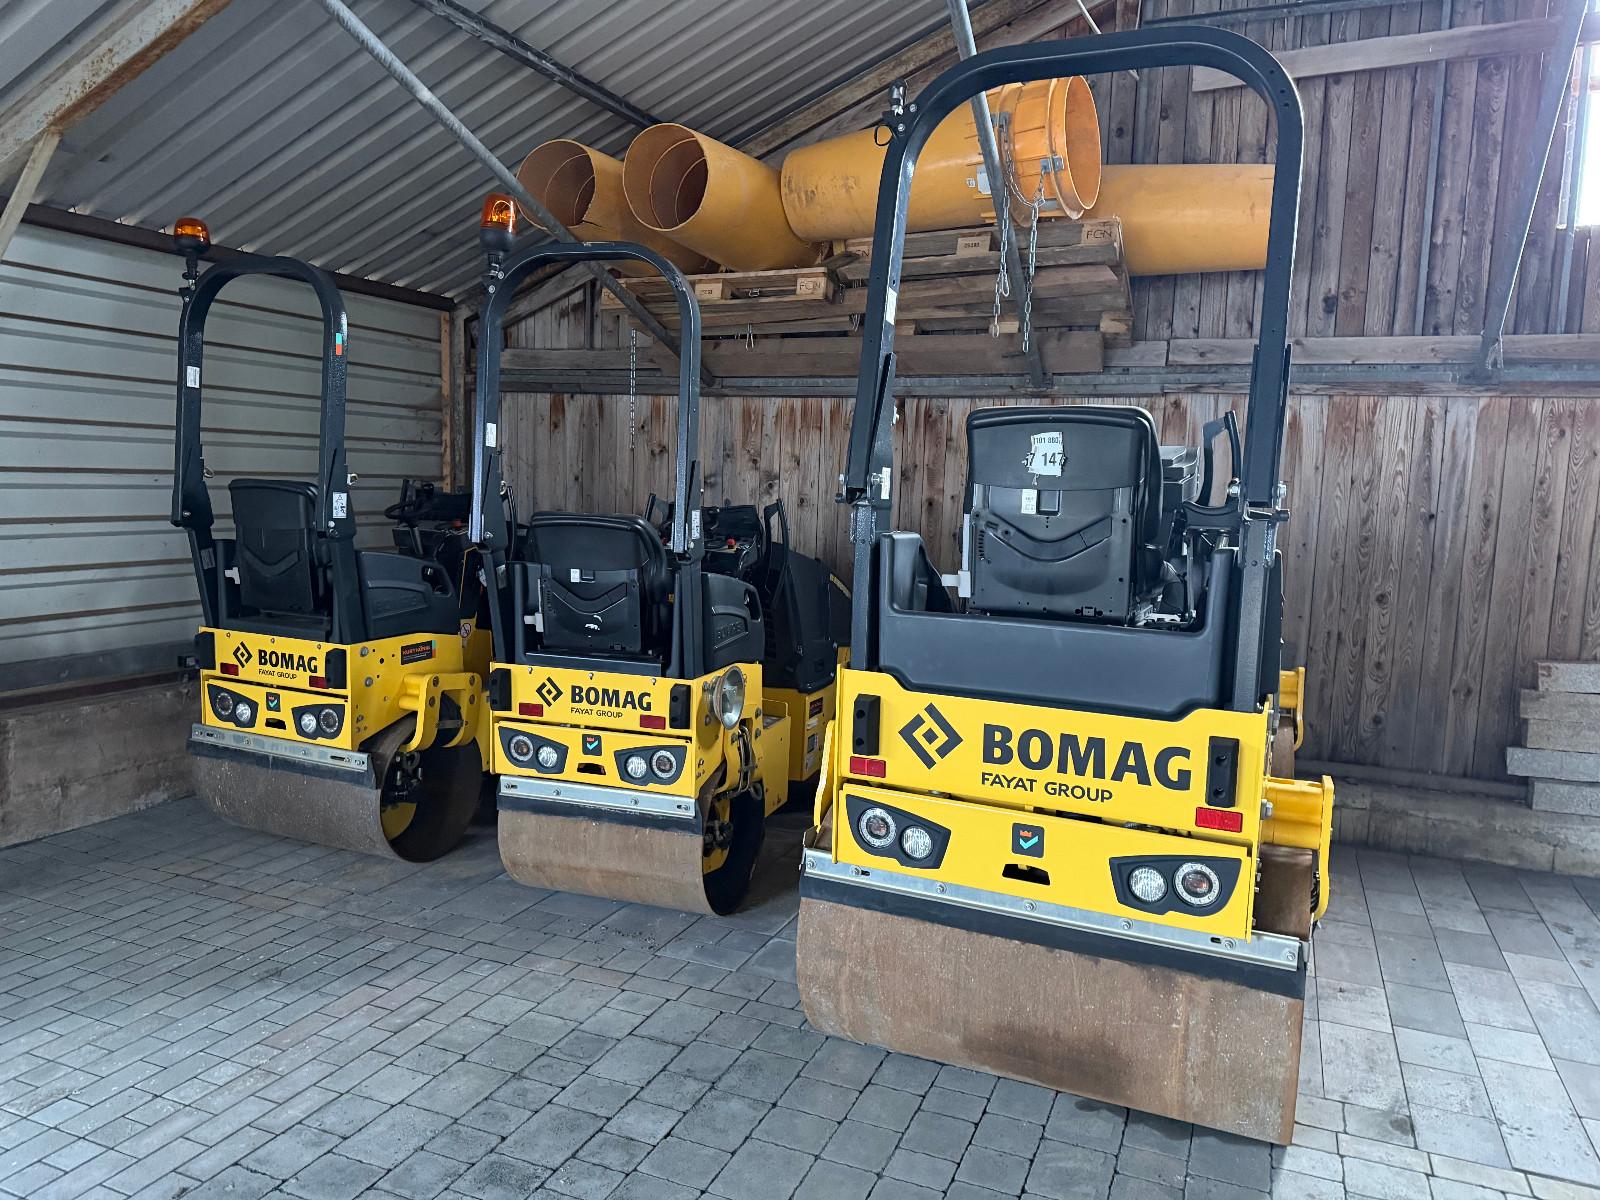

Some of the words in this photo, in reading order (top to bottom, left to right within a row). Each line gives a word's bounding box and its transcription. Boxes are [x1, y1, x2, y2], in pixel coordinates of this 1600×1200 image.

[258, 649, 318, 674] BOMAG
[258, 668, 276, 677] FAYAT
[278, 671, 297, 679] GROUP
[571, 685, 652, 712] BOMAG
[570, 707, 593, 716] FAYAT
[596, 709, 623, 719] GROUP
[982, 723, 1192, 791] BOMAG
[981, 772, 1037, 792] FAYAT
[1044, 781, 1113, 803] GROUP
